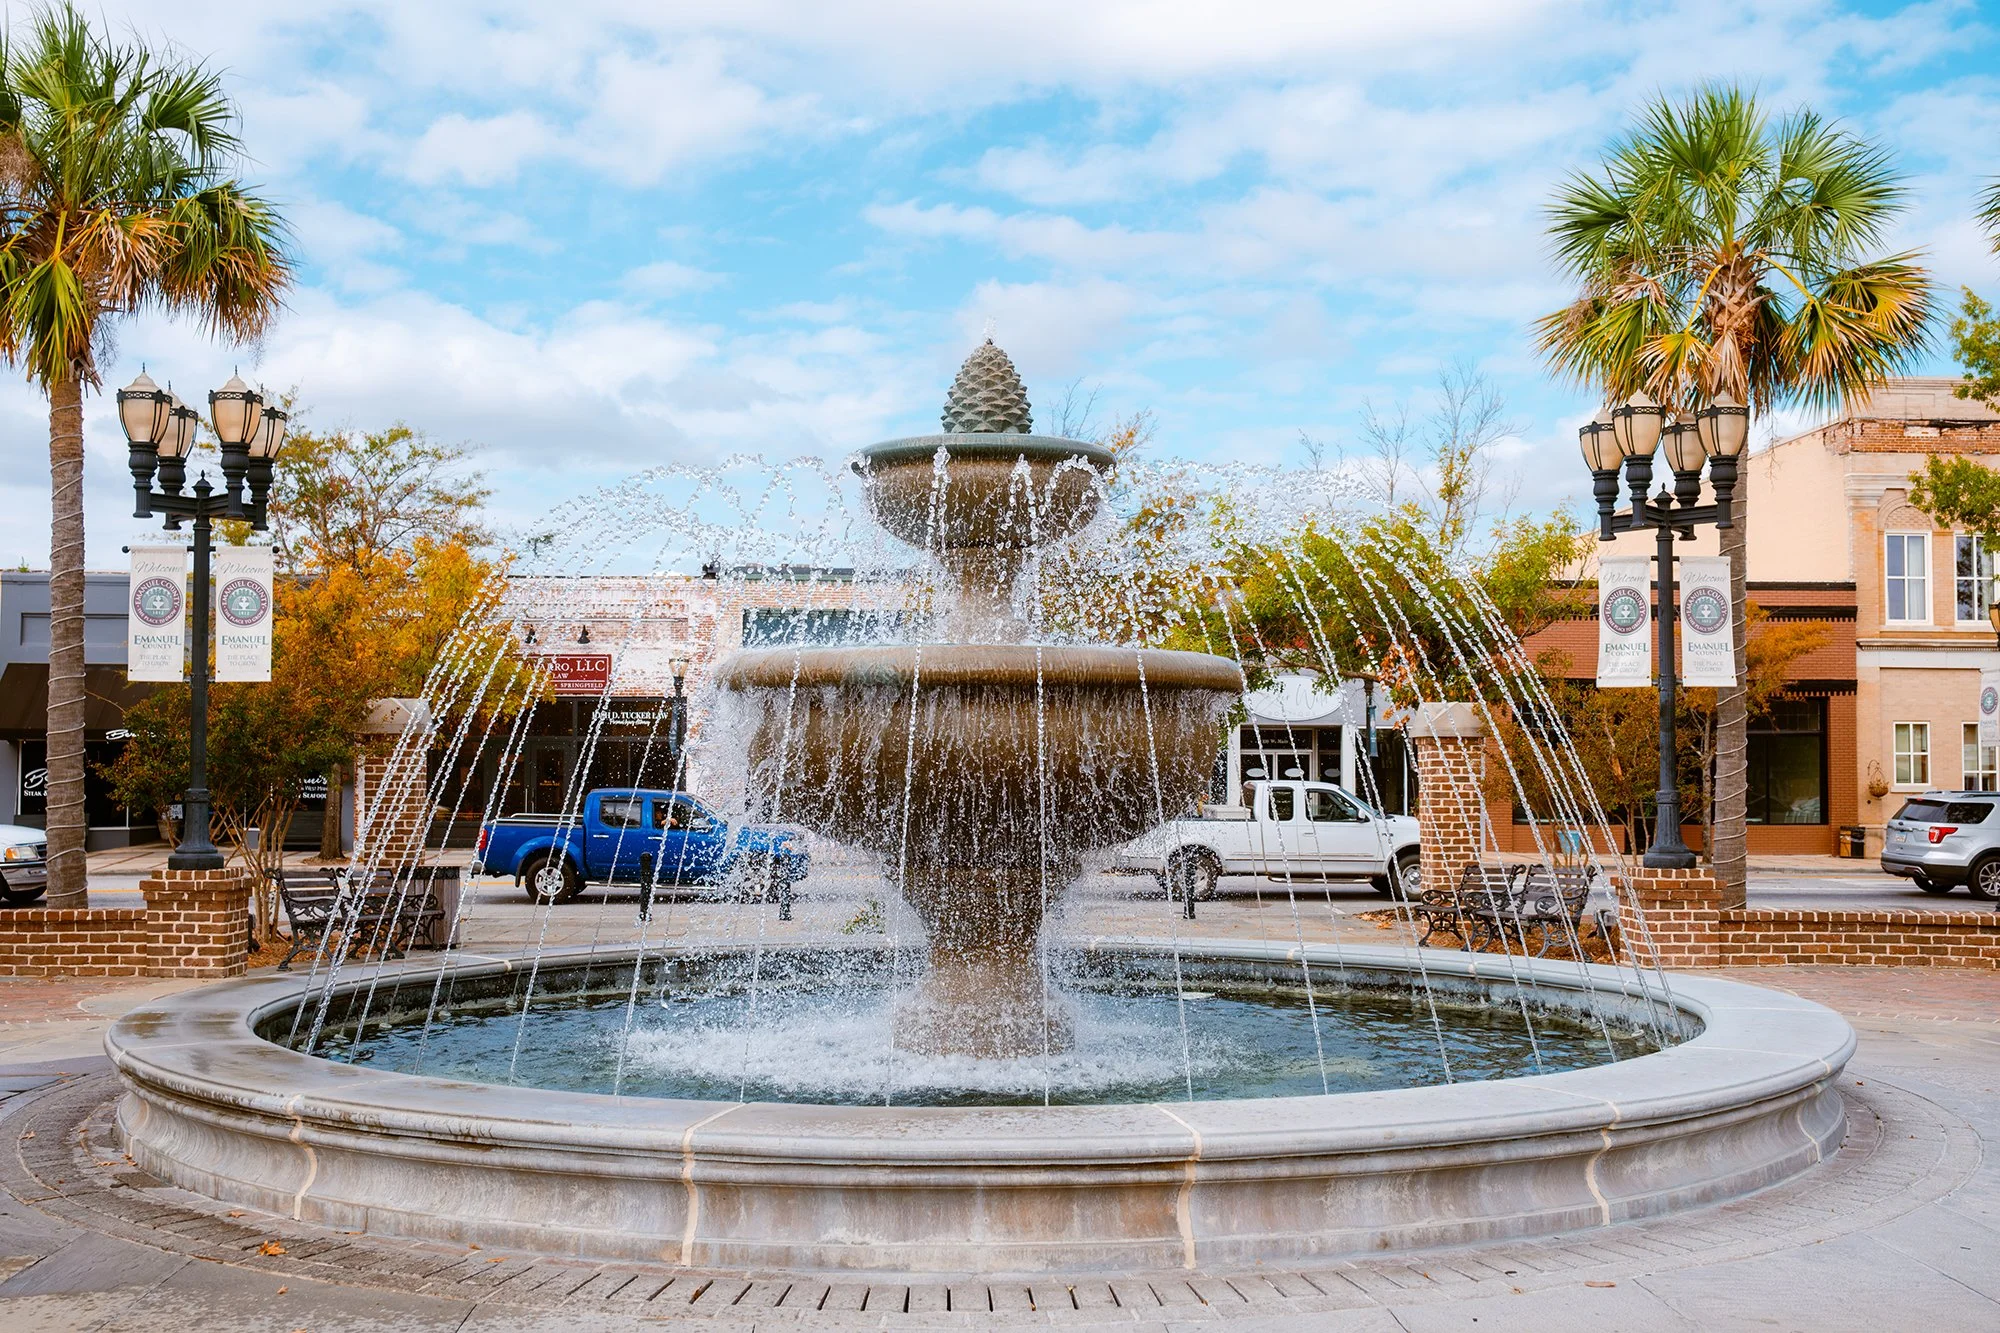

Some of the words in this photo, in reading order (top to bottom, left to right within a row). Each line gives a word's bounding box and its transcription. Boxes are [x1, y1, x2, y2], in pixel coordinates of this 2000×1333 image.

[135, 561, 182, 573] Welcome
[220, 562, 268, 574] Welcome
[1604, 572, 1646, 584] Welcome
[1684, 572, 1726, 584] Welcome
[134, 579, 160, 606] EMANUEL
[160, 580, 180, 609] COUNTY
[220, 581, 246, 607] EMANUEL
[246, 581, 267, 610] COUNTY
[1605, 589, 1627, 615] EMANUEL
[1627, 590, 1646, 616] COUNTY
[1686, 589, 1708, 614] EMANUEL
[1707, 589, 1728, 615] COUNTY
[134, 634, 182, 645] EMANUEL
[222, 635, 269, 645] EMANUEL
[1605, 643, 1649, 653] EMANUEL
[1688, 642, 1731, 652] EMANUEL
[576, 660, 605, 671] LLC
